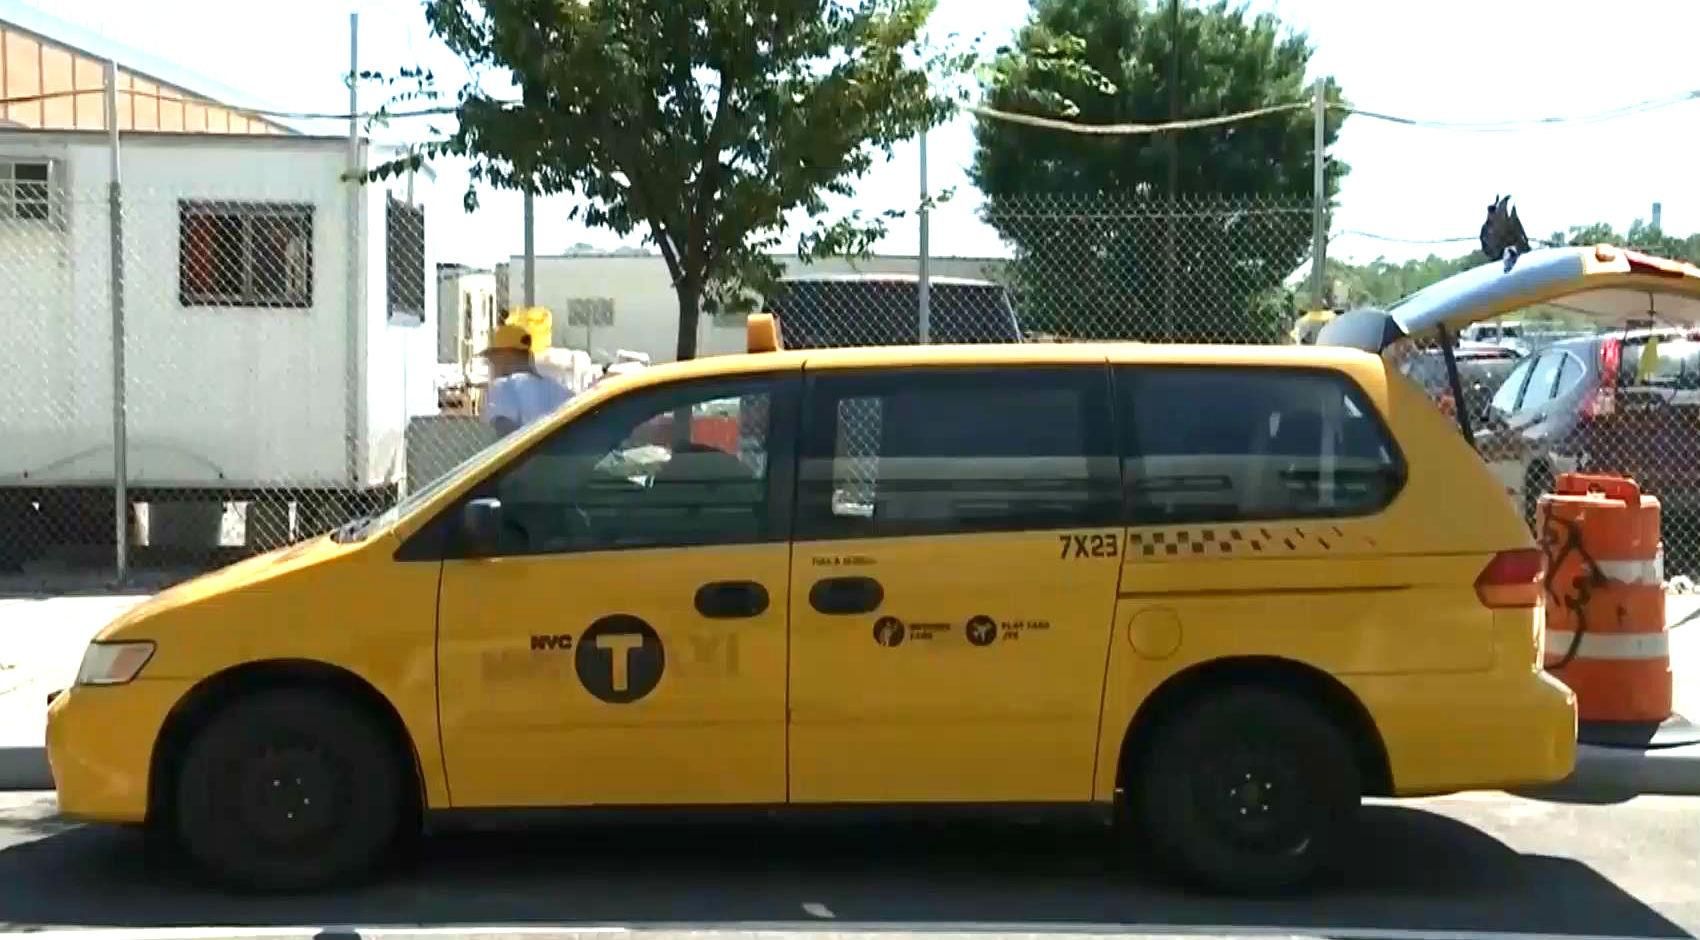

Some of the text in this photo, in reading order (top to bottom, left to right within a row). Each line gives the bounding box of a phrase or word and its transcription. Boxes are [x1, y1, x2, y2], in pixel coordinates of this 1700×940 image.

[1059, 534, 1118, 560] 7X23
[531, 634, 573, 650] NYC
[595, 634, 643, 690] T
